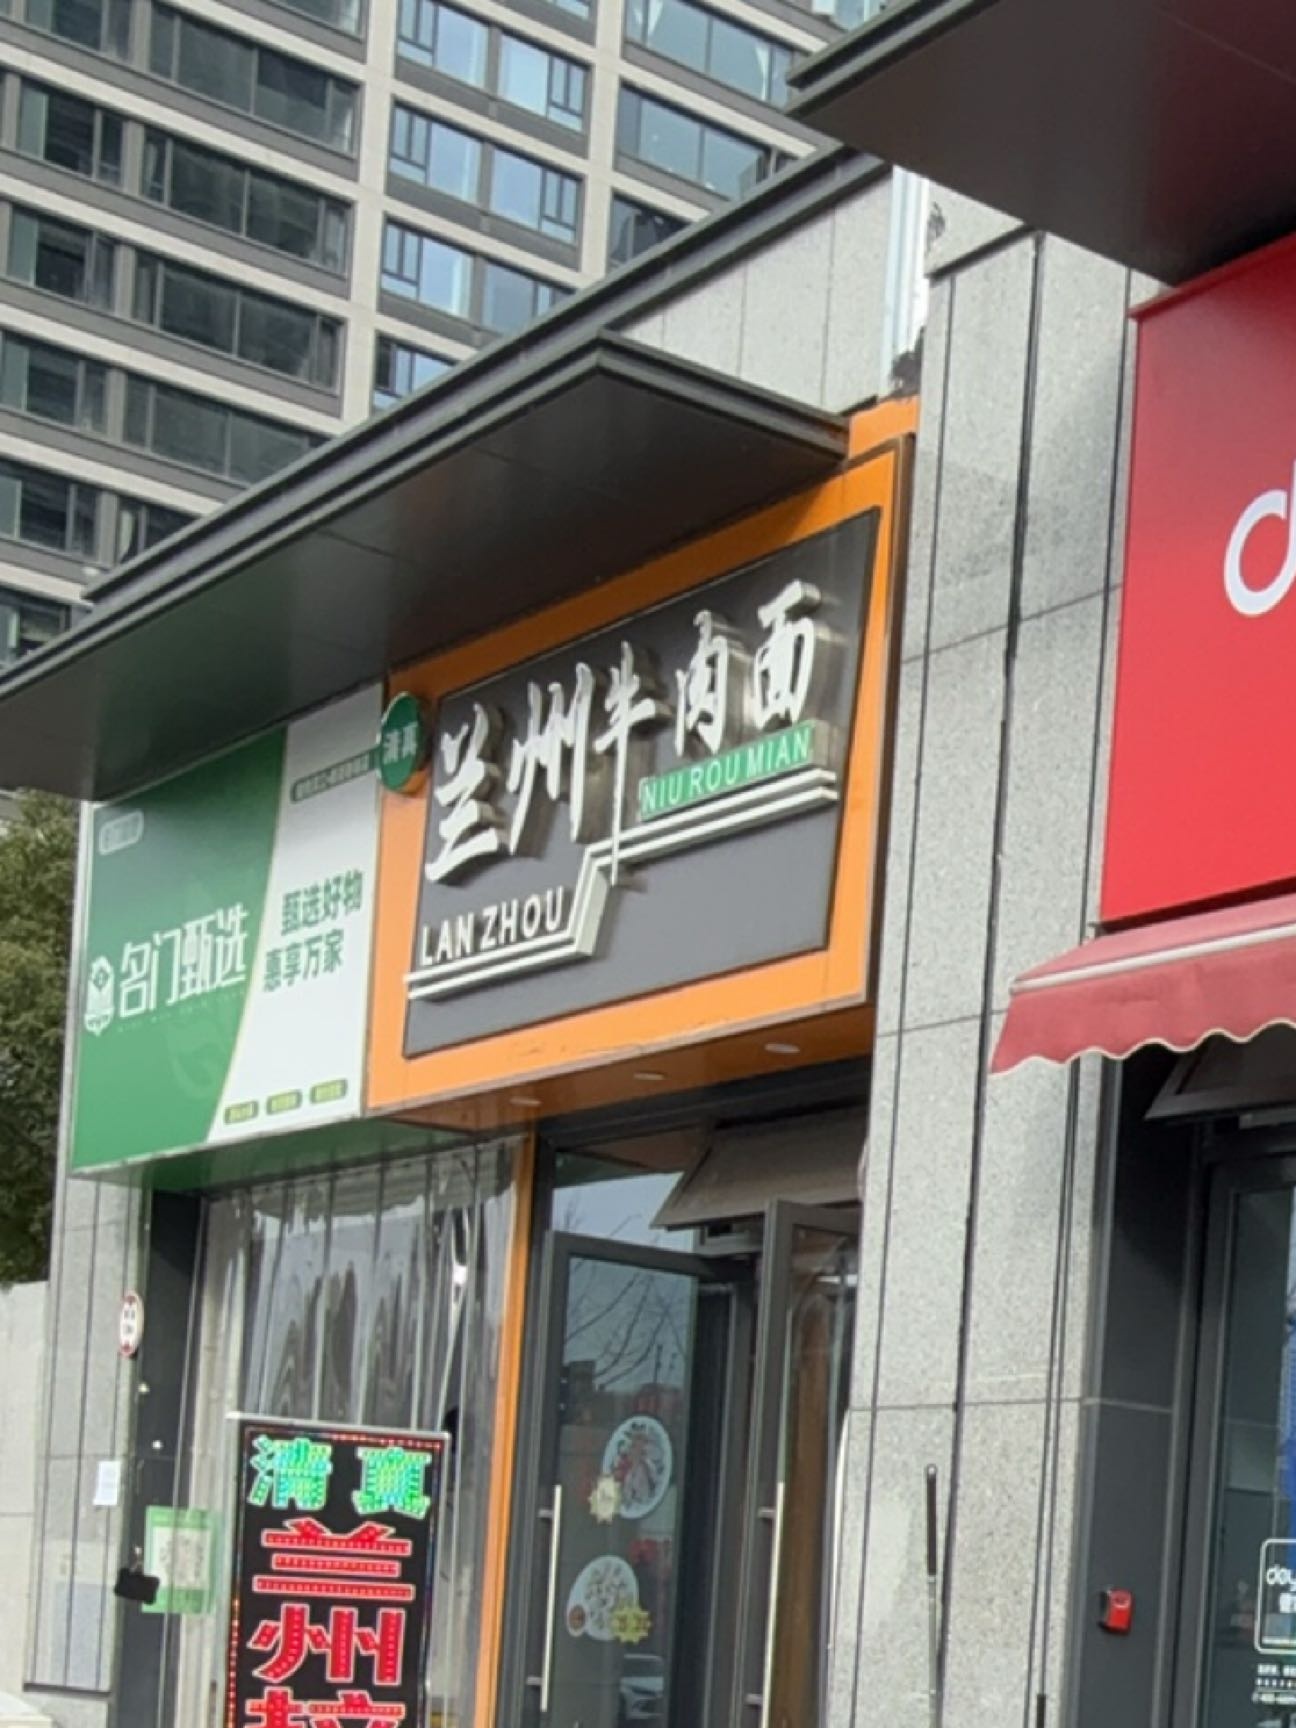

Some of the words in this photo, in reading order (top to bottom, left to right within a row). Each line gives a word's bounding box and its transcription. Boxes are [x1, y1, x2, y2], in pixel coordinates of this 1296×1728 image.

[424, 579, 823, 885] 兰州牛肉面
[642, 773, 685, 812] NIU
[688, 752, 741, 797] ROU
[745, 728, 812, 778] MIAN
[119, 902, 249, 1018] 名门甄选
[420, 914, 476, 966] LAN
[480, 885, 564, 950] ZHOU
